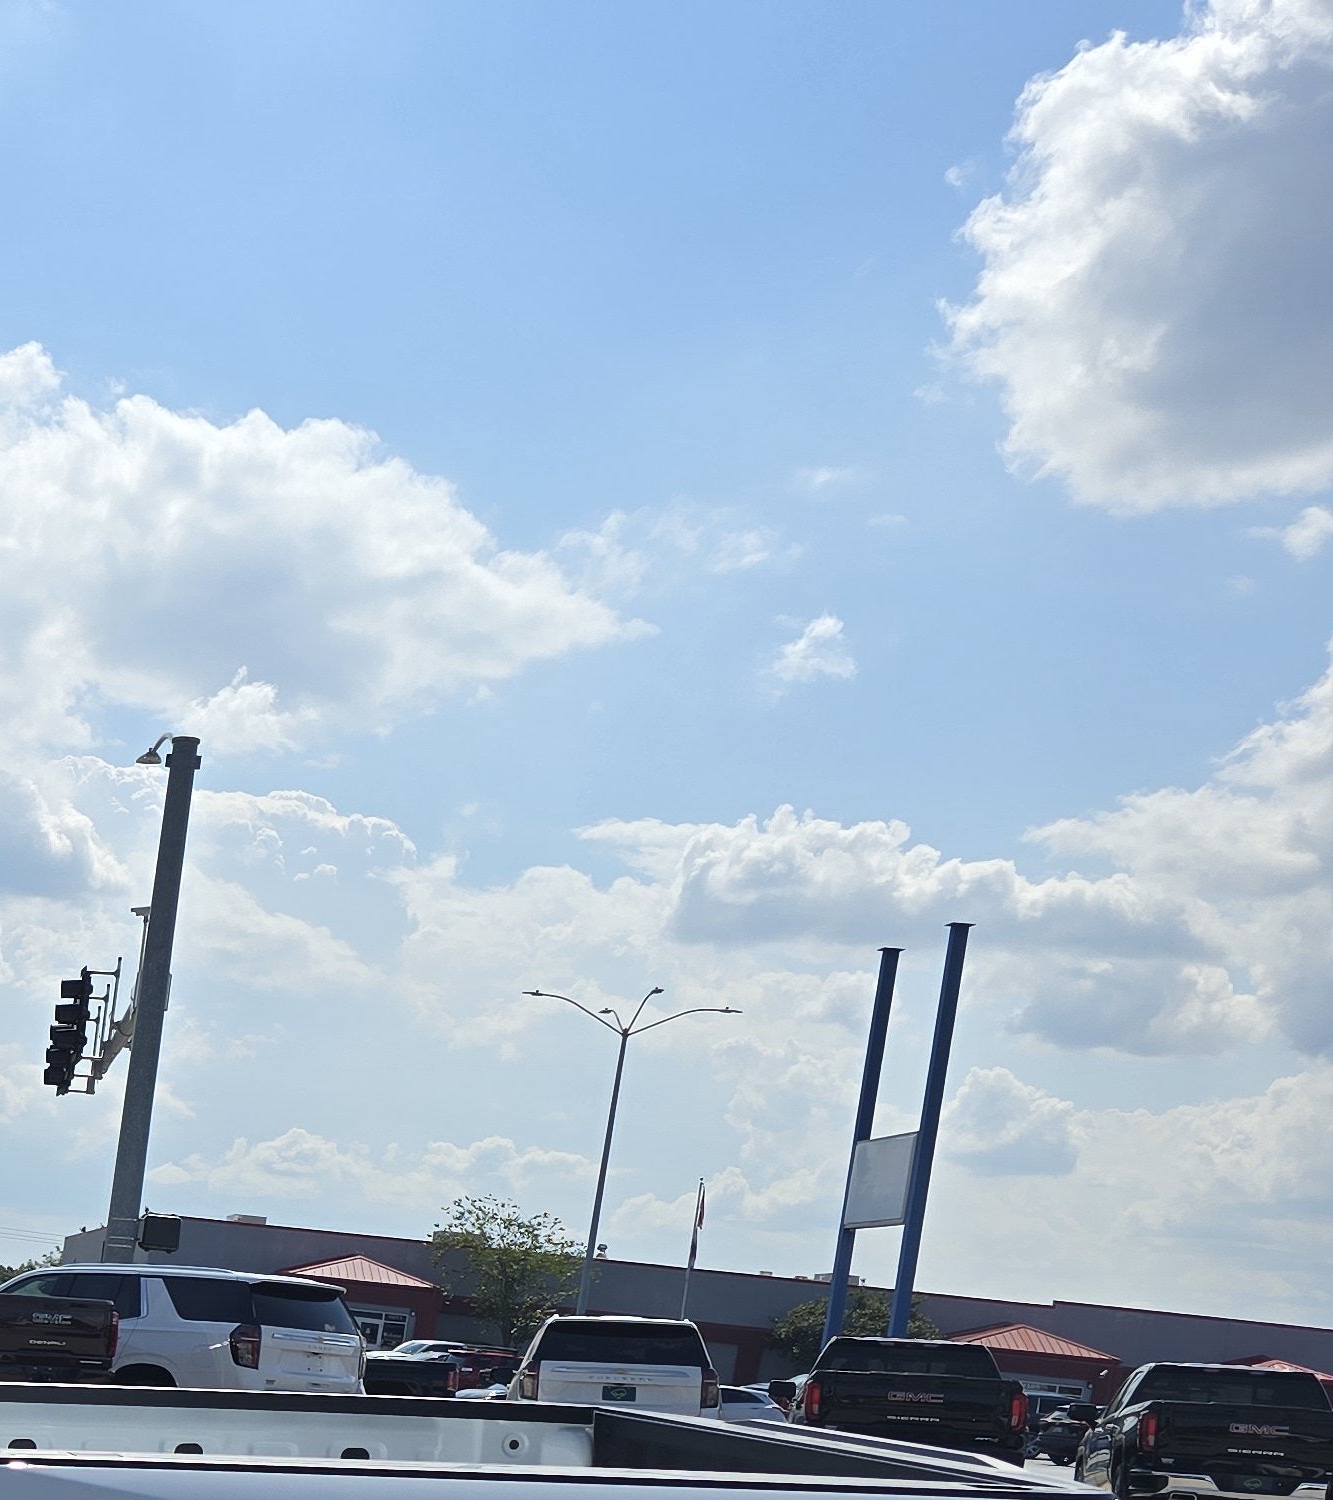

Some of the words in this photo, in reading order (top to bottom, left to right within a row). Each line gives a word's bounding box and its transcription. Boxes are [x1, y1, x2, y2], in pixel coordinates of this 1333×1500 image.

[32, 1312, 73, 1325] GMC
[887, 1391, 944, 1403] GMC
[1229, 1422, 1290, 1435] GMC
